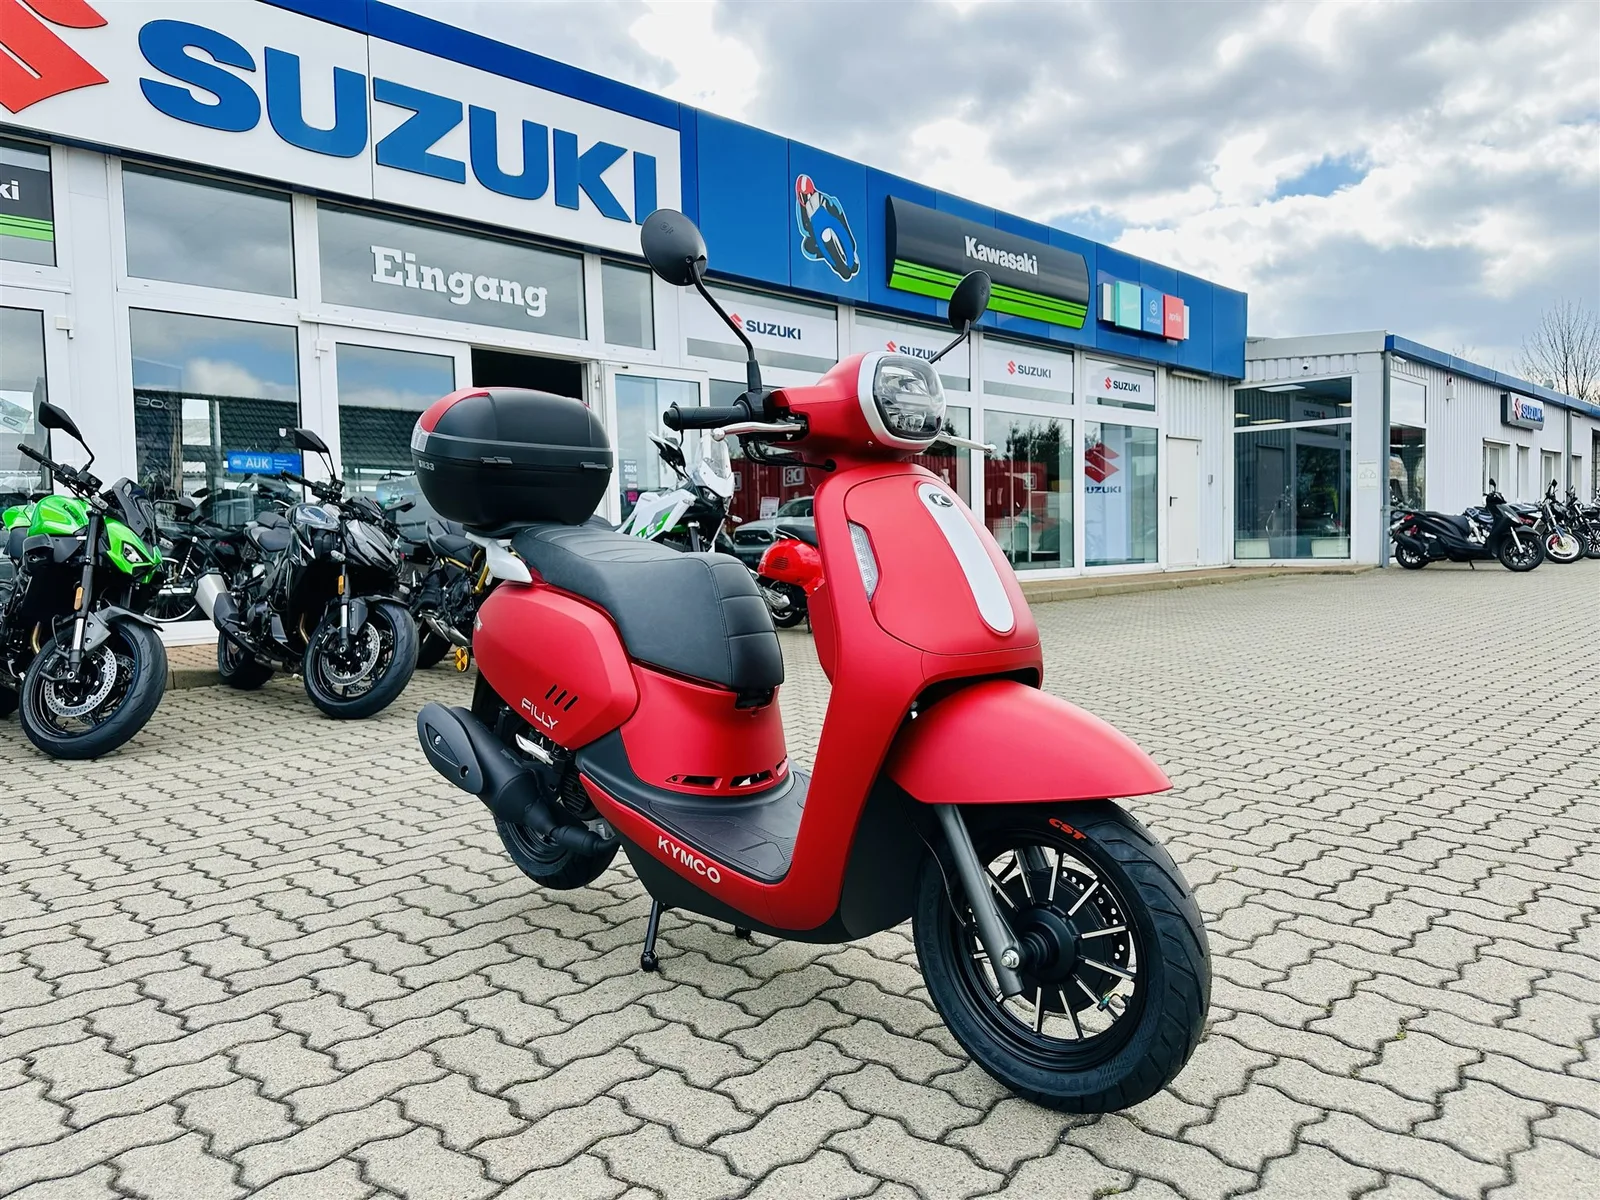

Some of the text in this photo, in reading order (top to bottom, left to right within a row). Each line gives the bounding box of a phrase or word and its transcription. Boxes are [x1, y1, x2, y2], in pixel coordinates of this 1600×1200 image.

[139, 18, 658, 226] SUZUKI
[964, 235, 1038, 275] Kawasaki
[370, 245, 548, 318] Eingang
[745, 319, 802, 340] SUZUKI
[1017, 364, 1052, 378] SUZUKI
[1112, 380, 1141, 392] SUZUKI
[245, 457, 269, 469] AUK
[1084, 486, 1122, 494] UZUKI
[521, 697, 558, 730] FILLY
[1049, 818, 1087, 840] CST
[657, 835, 721, 884] KYMCO
